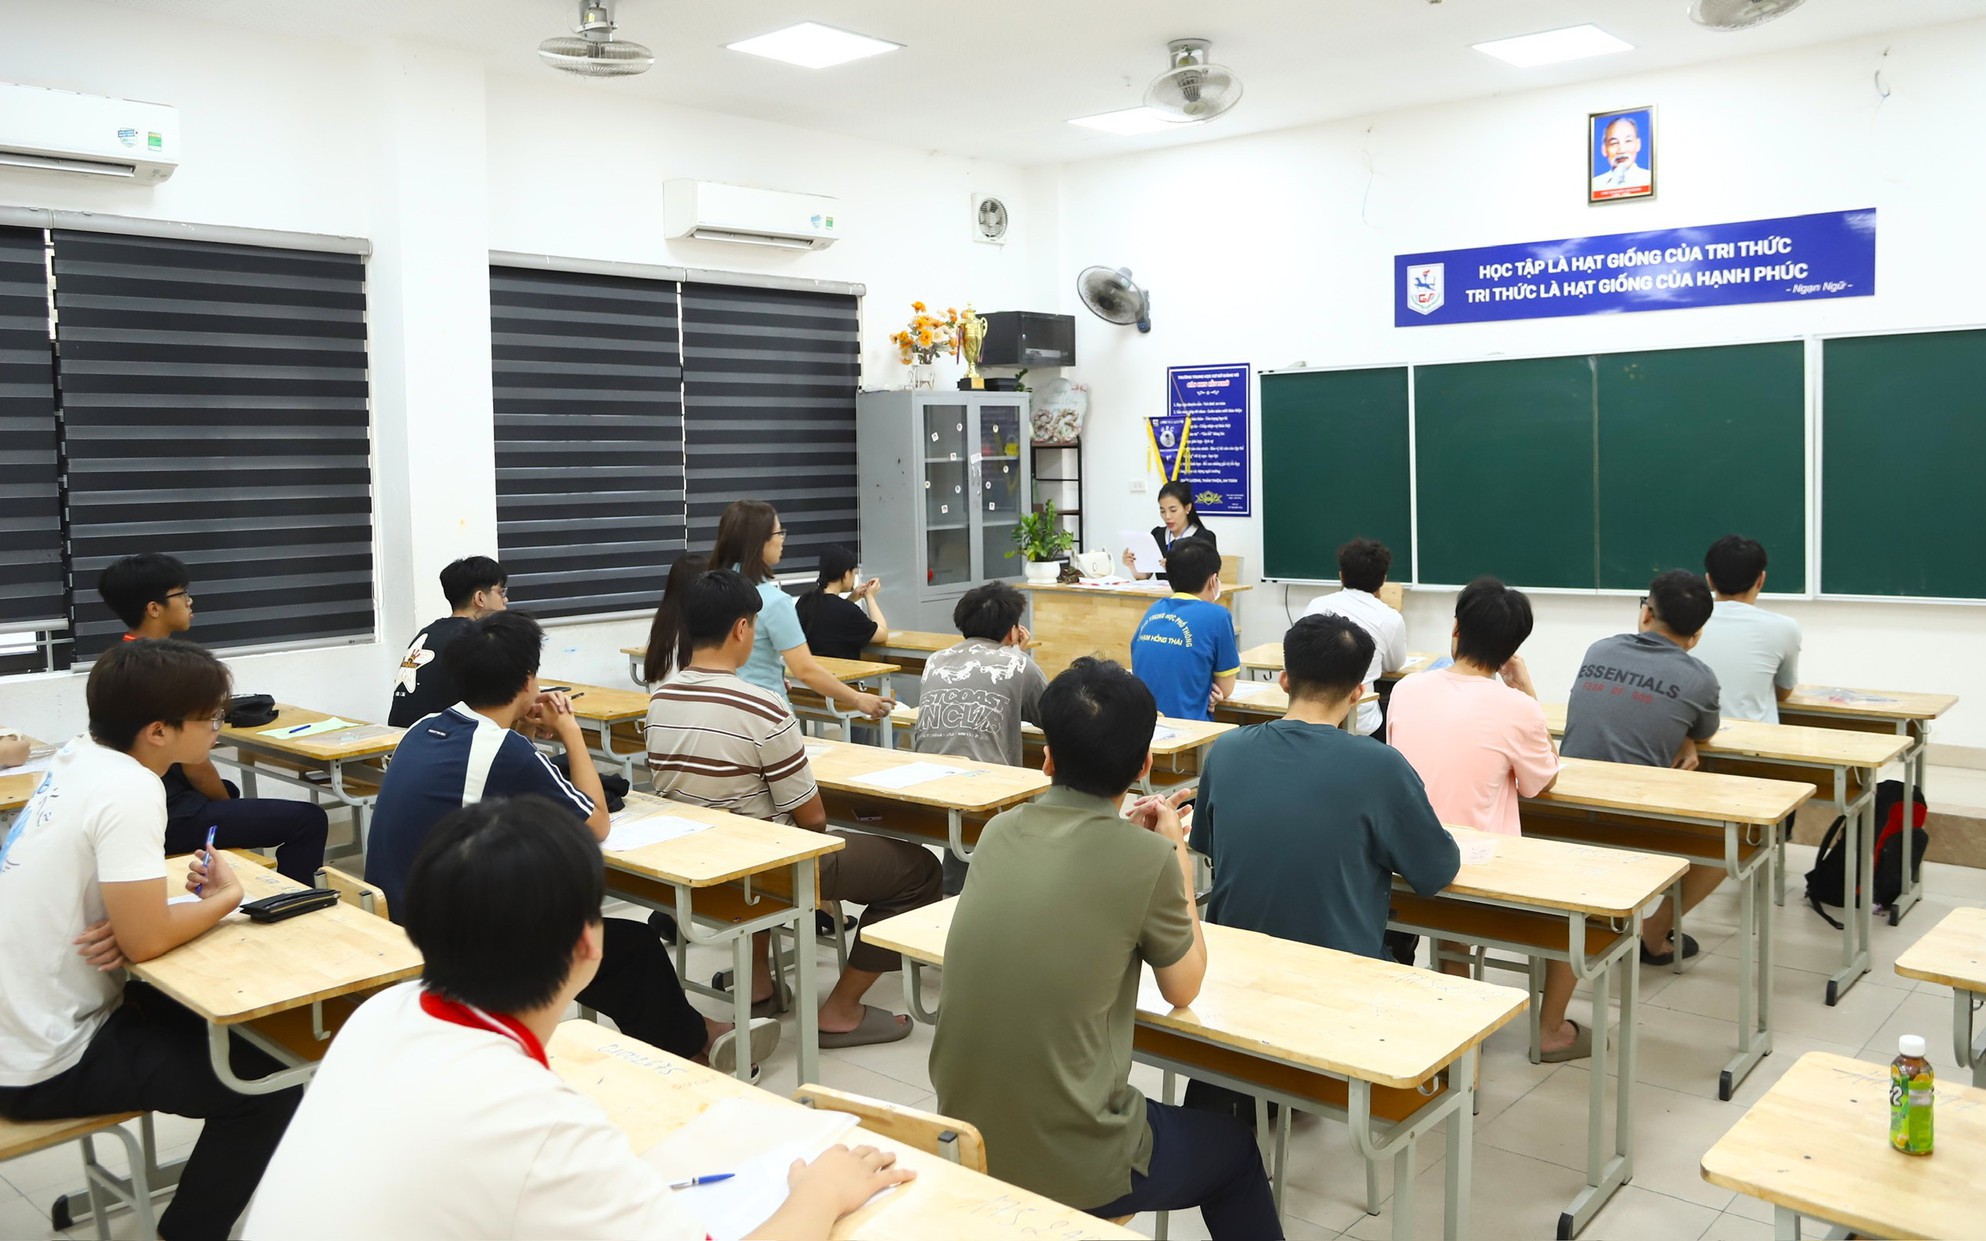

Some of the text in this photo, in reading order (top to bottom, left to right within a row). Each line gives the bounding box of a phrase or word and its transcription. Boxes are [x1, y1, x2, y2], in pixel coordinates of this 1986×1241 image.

[1478, 235, 1792, 281] HỌC TẬP LÀ HẠT GIỐNG CỦA TRI THỨC
[1465, 260, 1809, 303] TRI THỨC LÀ HẠT GIỐNG CỦA HẠNH PHÚC
[1578, 664, 1680, 699] ESSENTIALS
